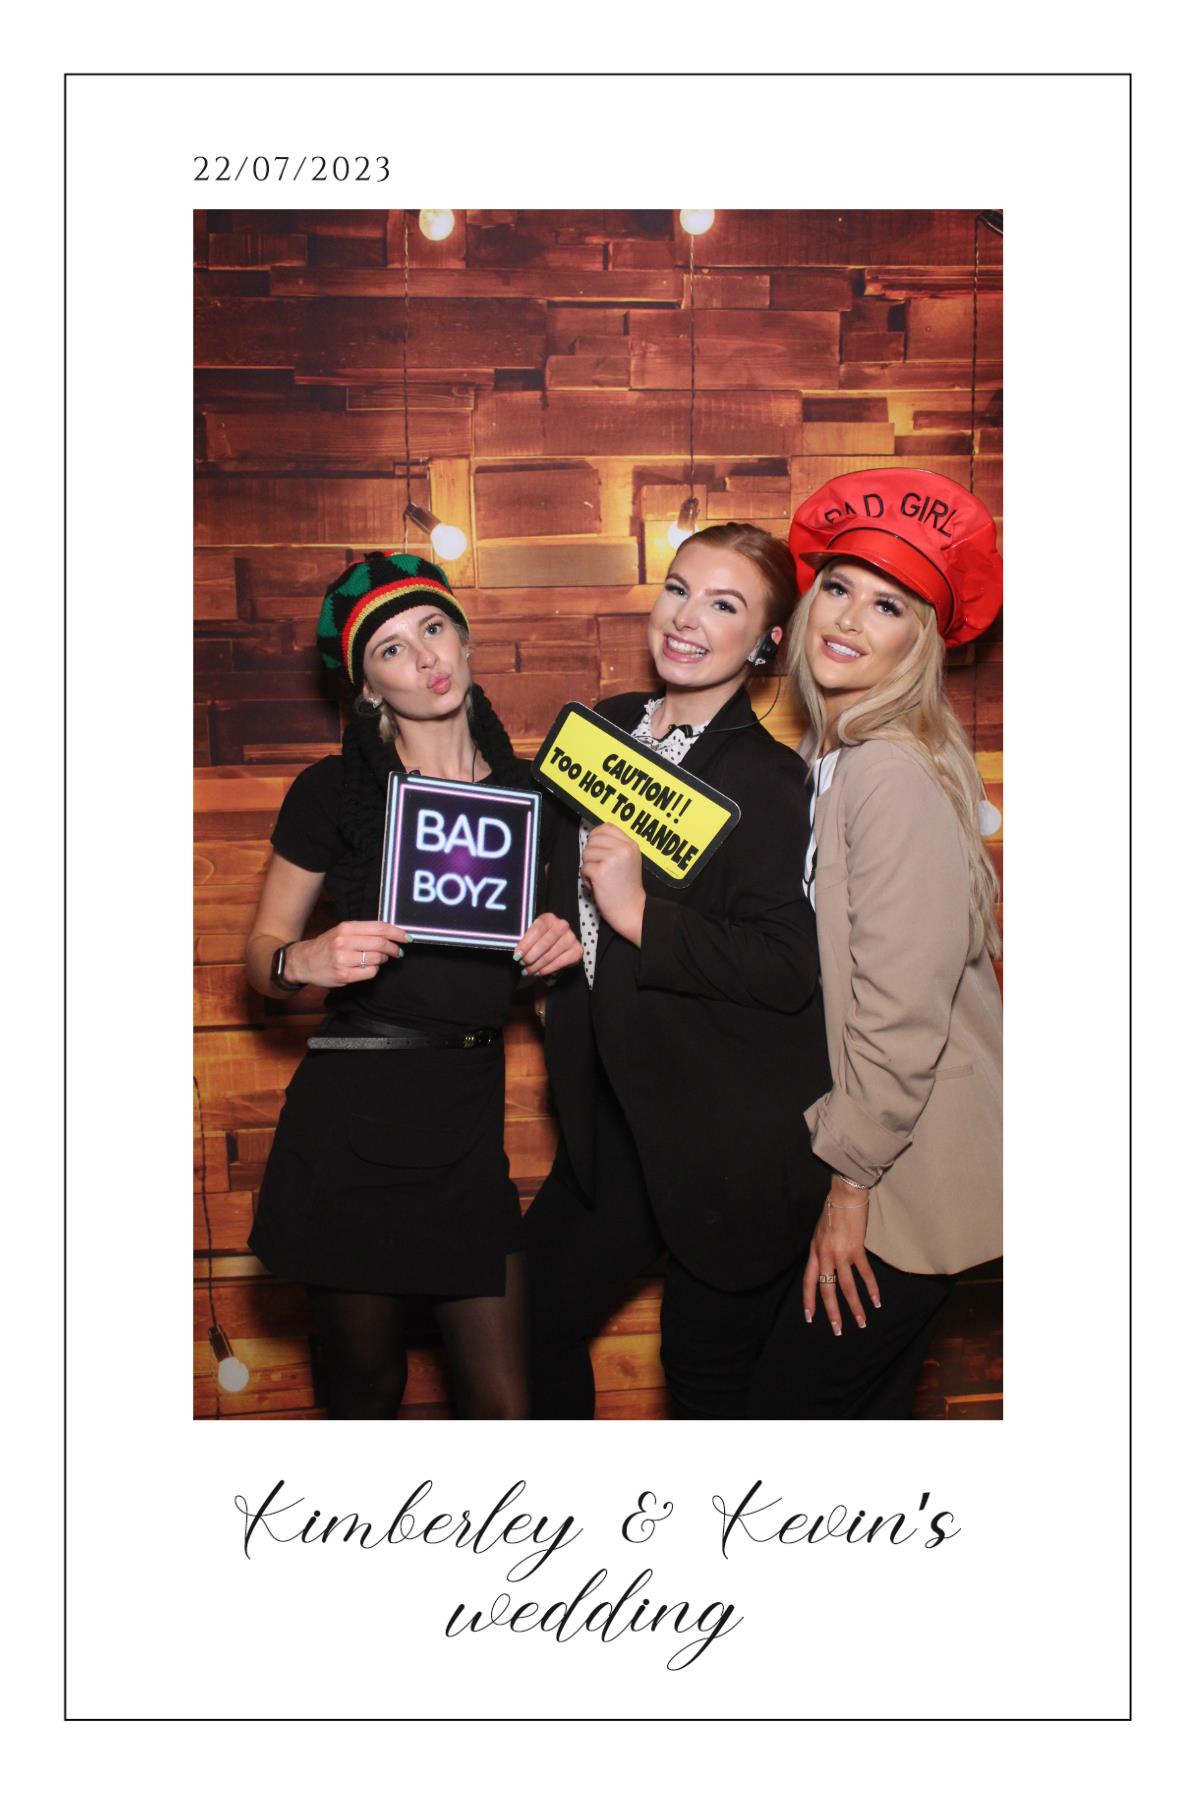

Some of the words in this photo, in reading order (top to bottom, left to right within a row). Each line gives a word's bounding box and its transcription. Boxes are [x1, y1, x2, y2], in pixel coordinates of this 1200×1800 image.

[900, 492, 957, 538] GIRL
[550, 746, 582, 780] TOO
[579, 770, 616, 805] HOT
[611, 793, 635, 822] TO
[630, 811, 699, 871] HANDLE
[602, 753, 692, 824] CAUTION!!
[415, 808, 512, 859] BAD
[412, 869, 508, 910] BOYZ
